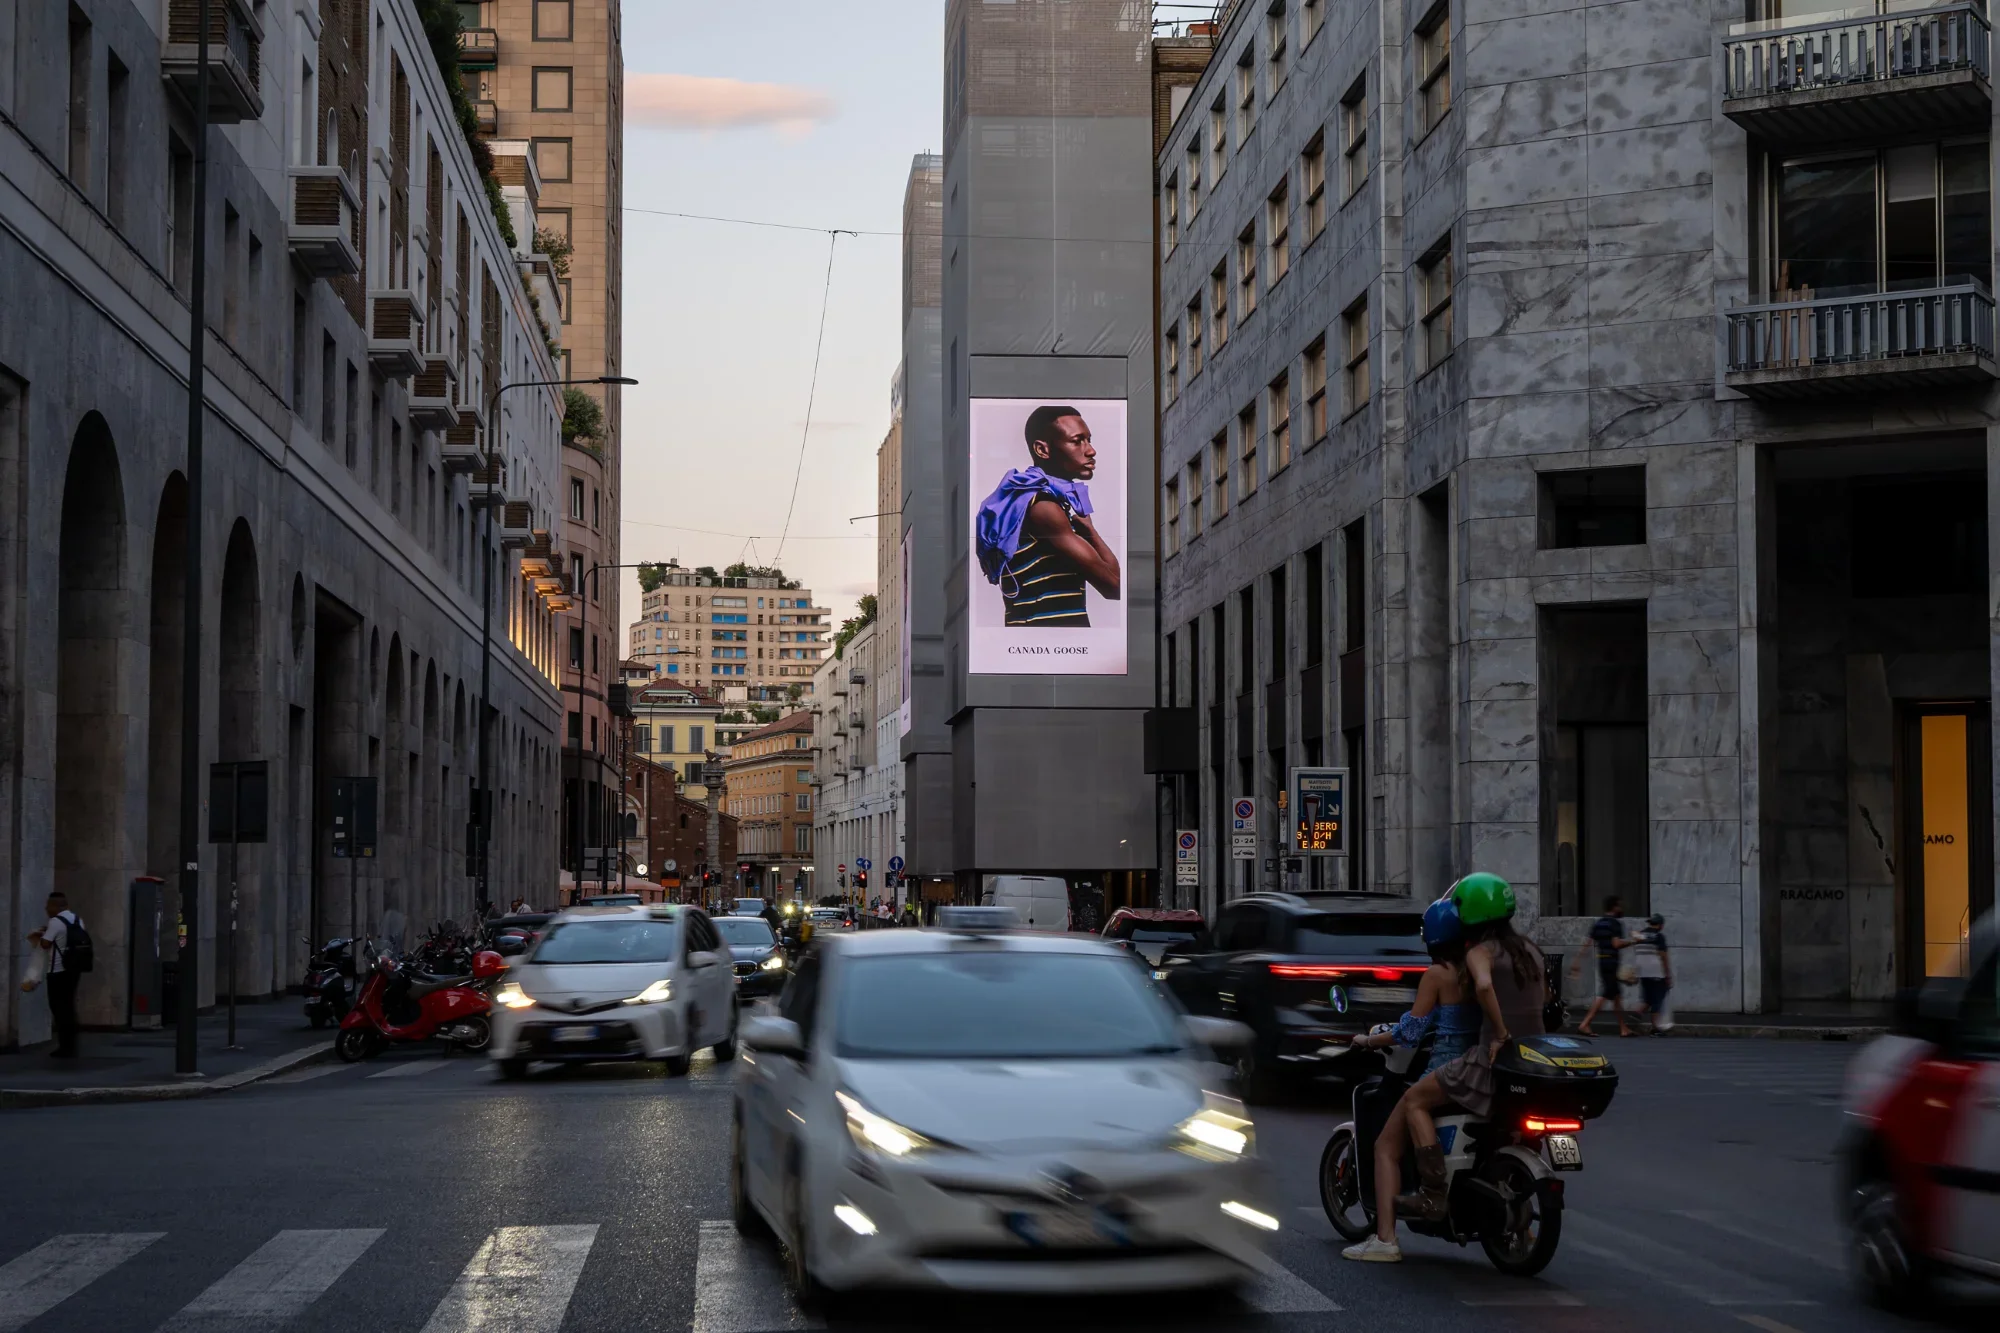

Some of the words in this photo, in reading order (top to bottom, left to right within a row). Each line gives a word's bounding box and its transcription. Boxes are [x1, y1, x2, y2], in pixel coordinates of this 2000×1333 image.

[1008, 646, 1050, 655] CANADA
[1053, 646, 1089, 655] GOOSE
[1302, 821, 1338, 831] LBERO
[1296, 831, 1332, 840] 3.0/H
[1302, 840, 1326, 849] ERO
[1552, 1138, 1575, 1150] X8L
[1556, 1151, 1576, 1162] GKY
